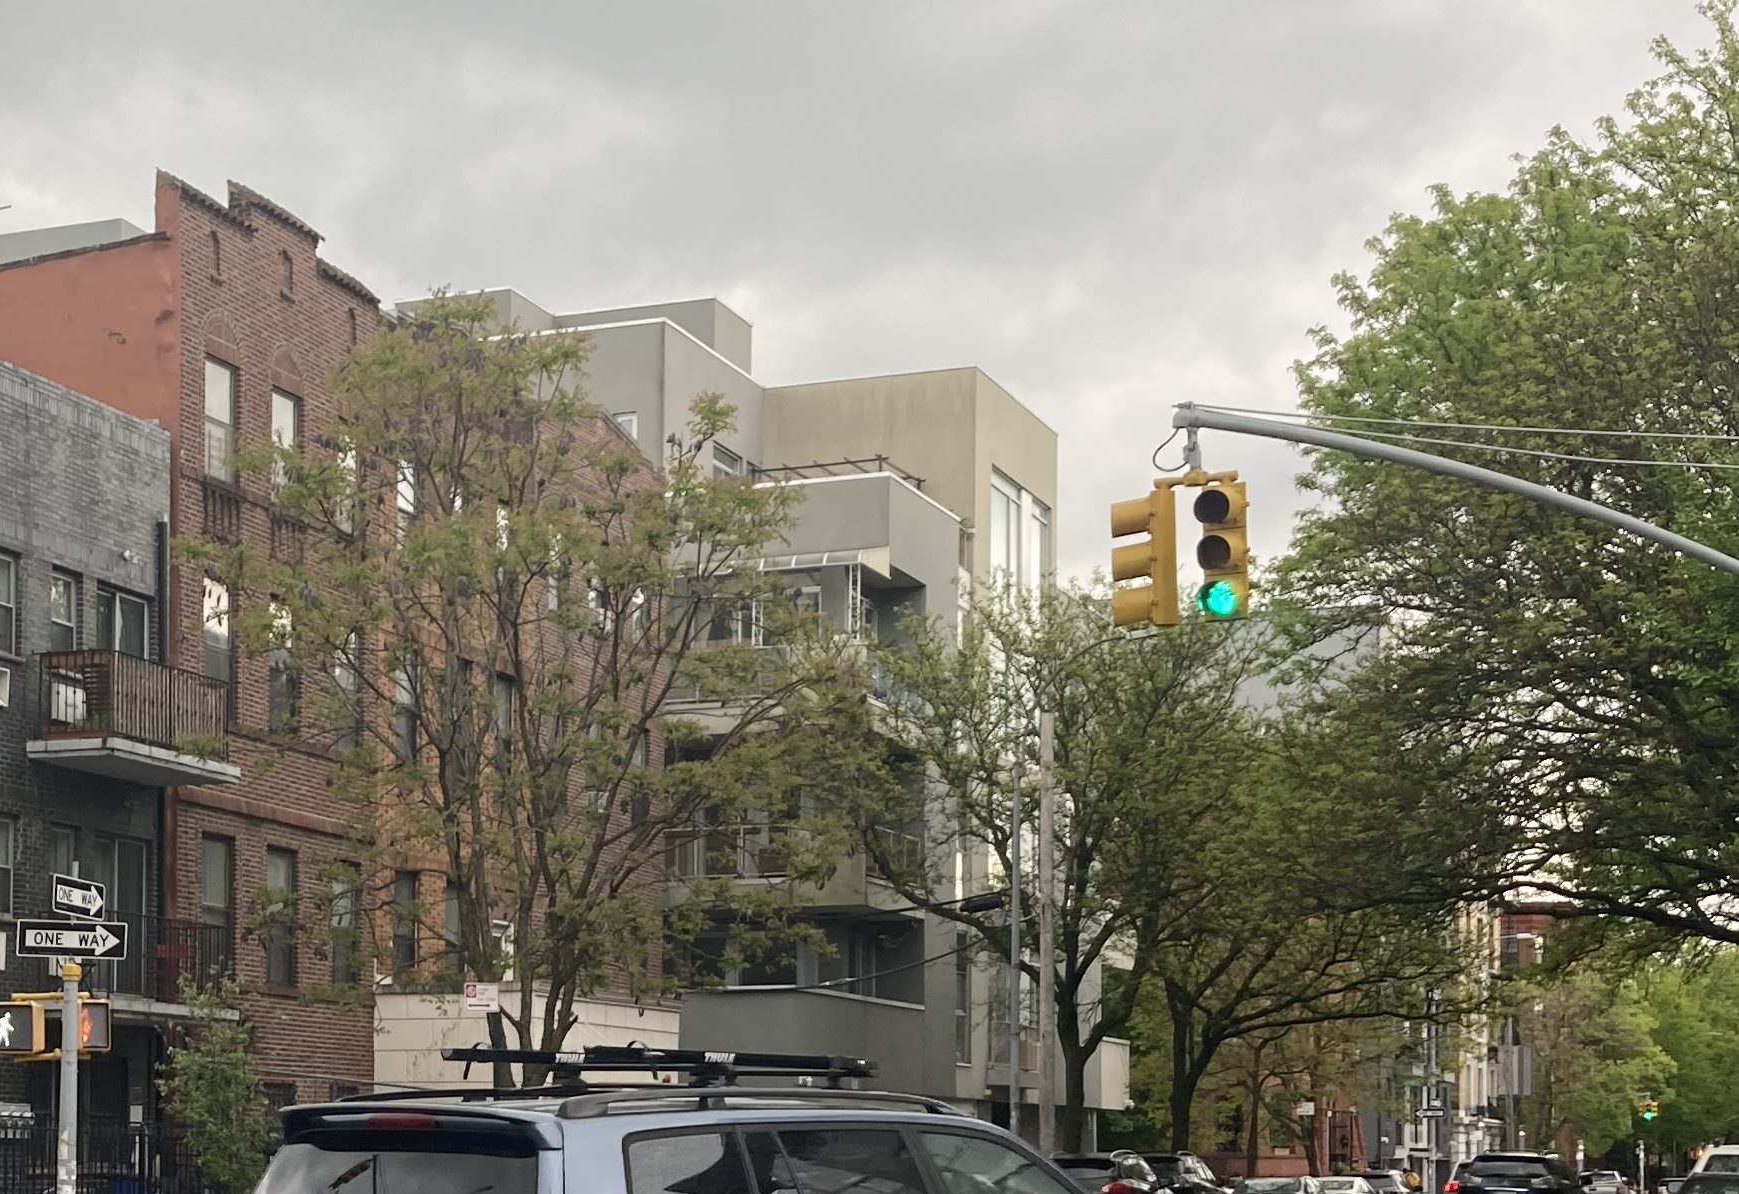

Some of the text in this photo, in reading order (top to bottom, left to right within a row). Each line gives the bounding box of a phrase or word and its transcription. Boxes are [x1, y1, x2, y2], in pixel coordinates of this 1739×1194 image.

[58, 886, 98, 907] ONE WAY
[34, 931, 110, 948] ONE WAY
